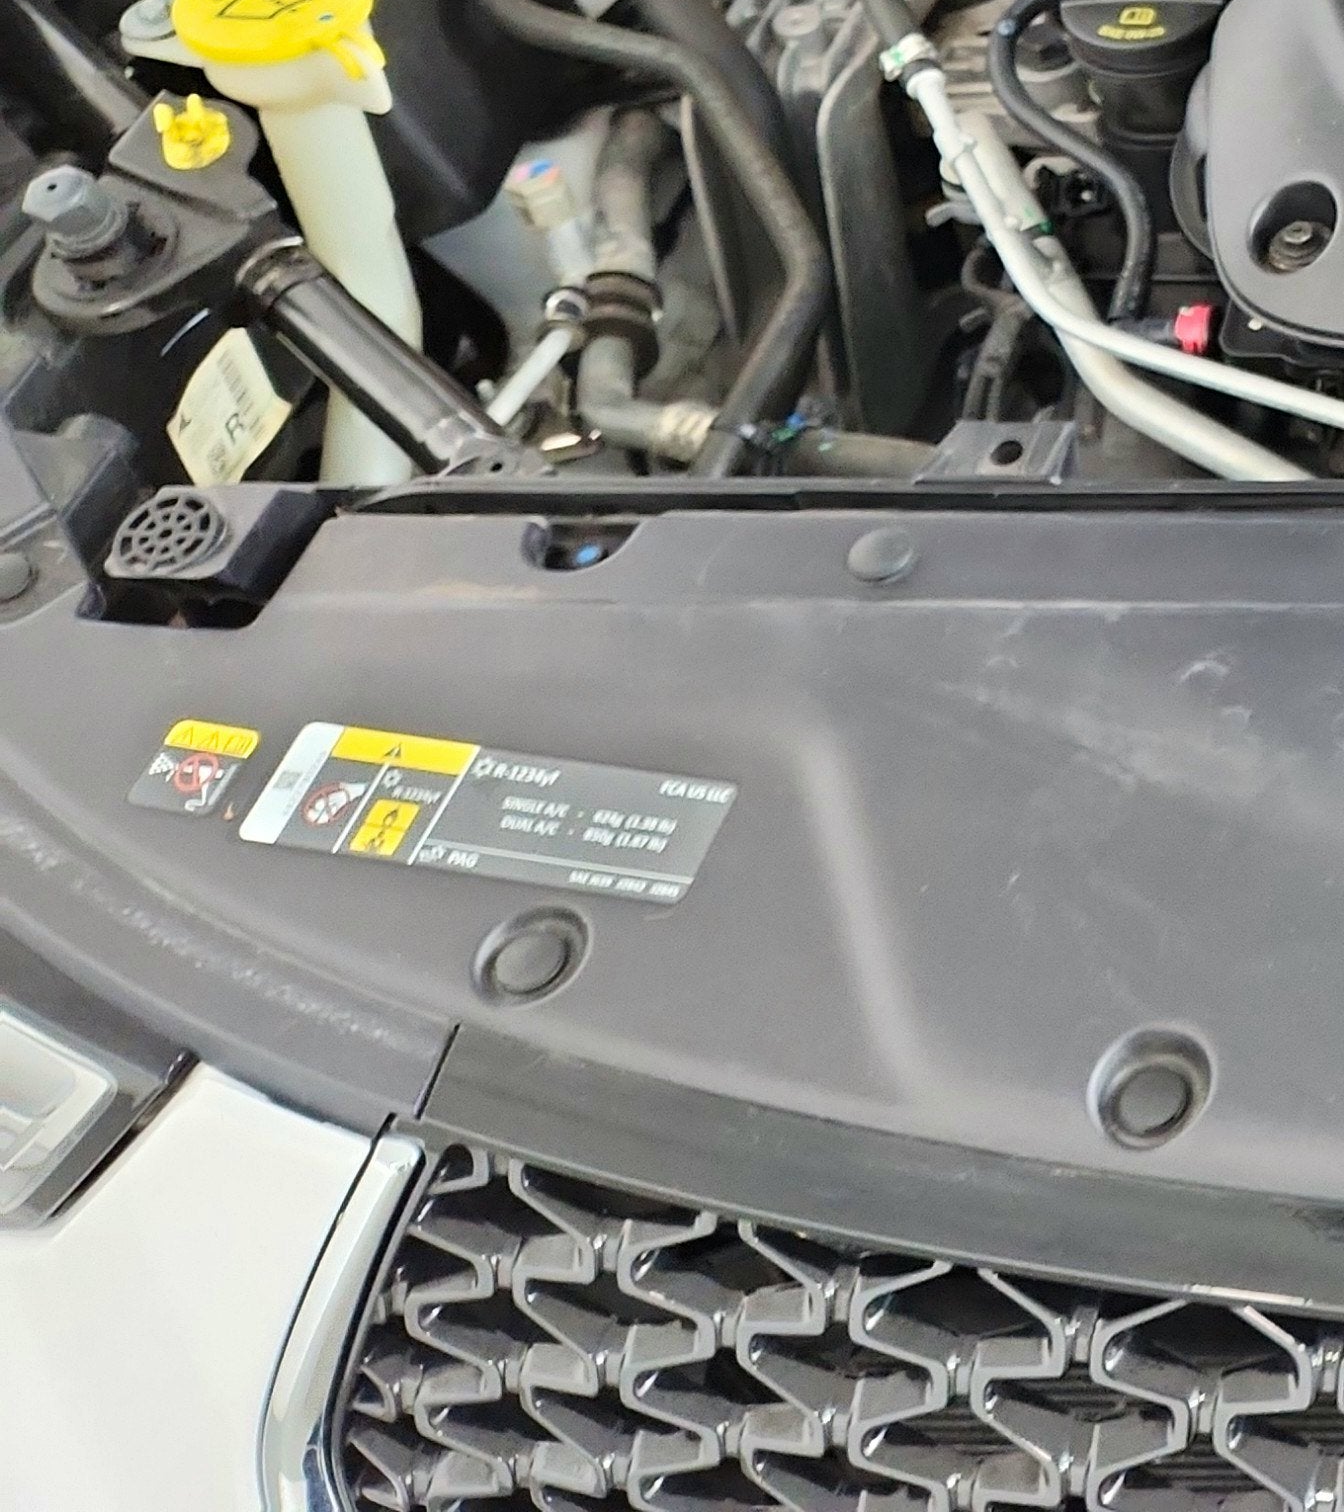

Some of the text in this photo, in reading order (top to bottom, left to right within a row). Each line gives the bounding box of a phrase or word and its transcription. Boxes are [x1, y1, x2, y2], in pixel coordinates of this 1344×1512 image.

[492, 762, 562, 787] R-1234yf
[659, 779, 735, 804] FCA US LLC
[447, 849, 480, 868] PAG
